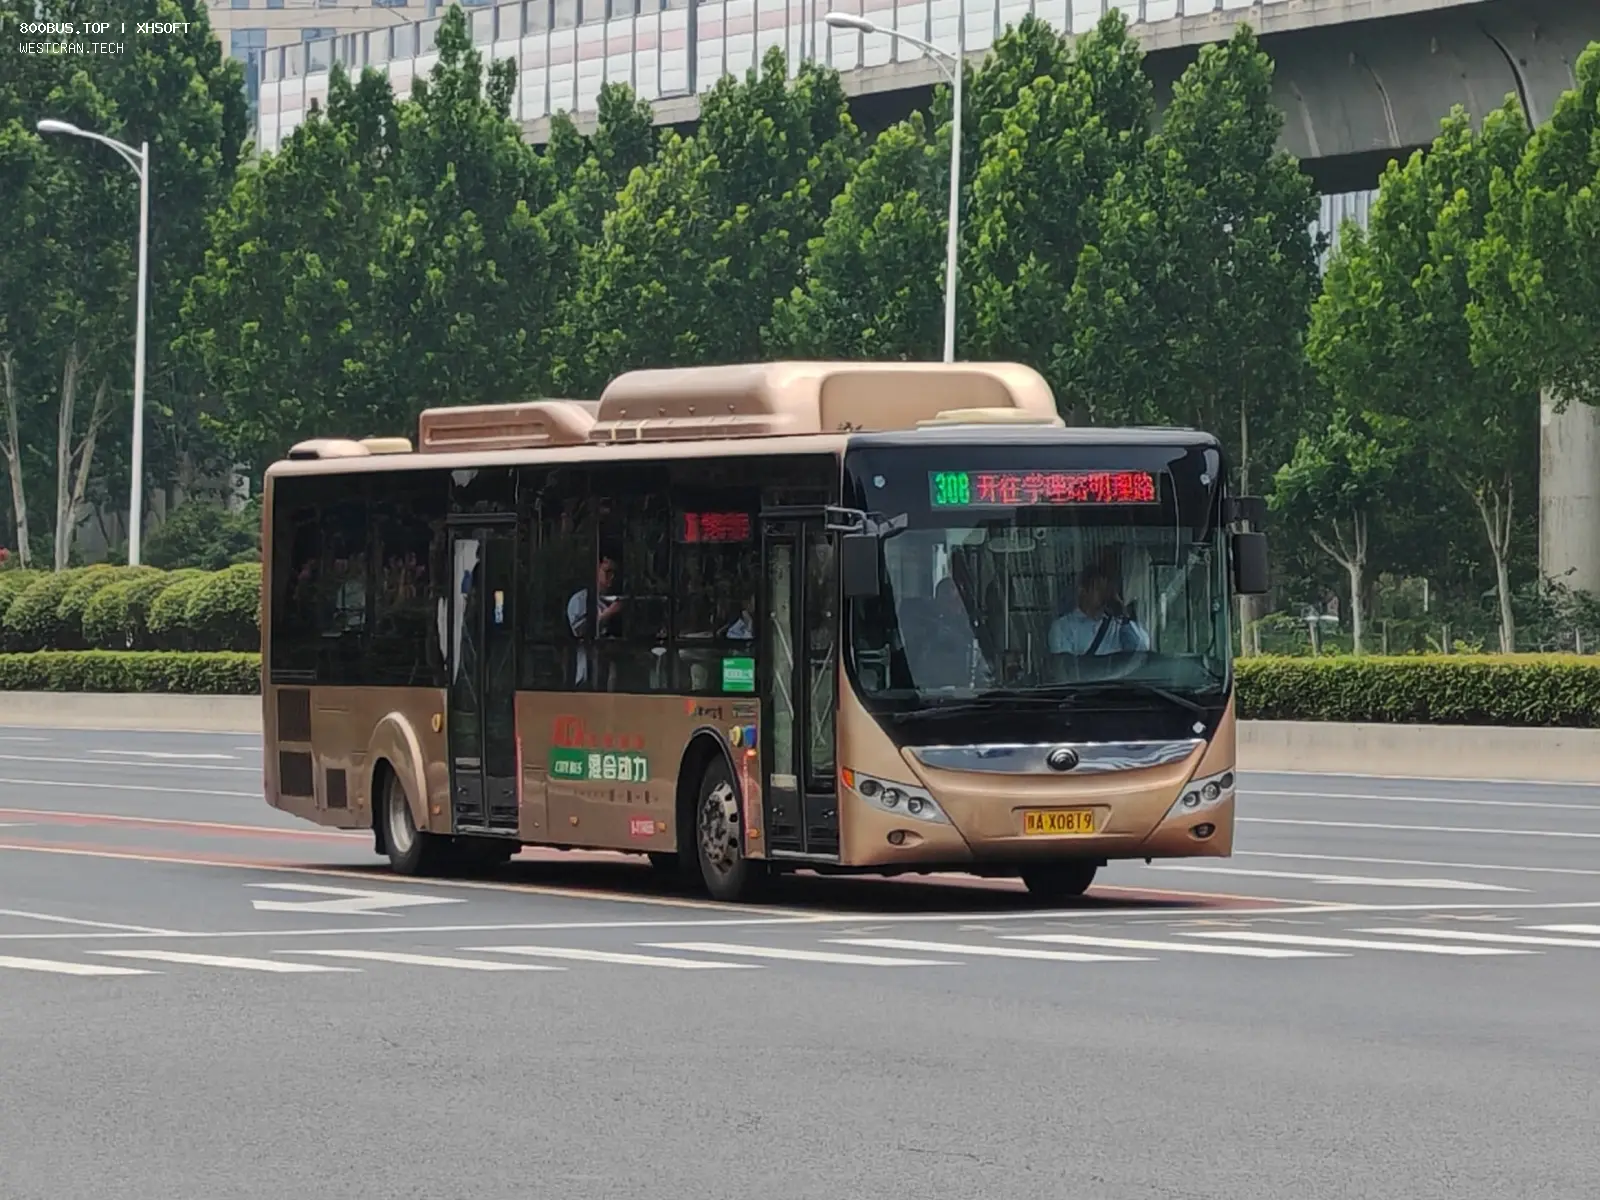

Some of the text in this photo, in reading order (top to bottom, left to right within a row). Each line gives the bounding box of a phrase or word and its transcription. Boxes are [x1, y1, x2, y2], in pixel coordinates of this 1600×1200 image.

[935, 472, 970, 504] 308
[587, 753, 648, 782] 混合动力
